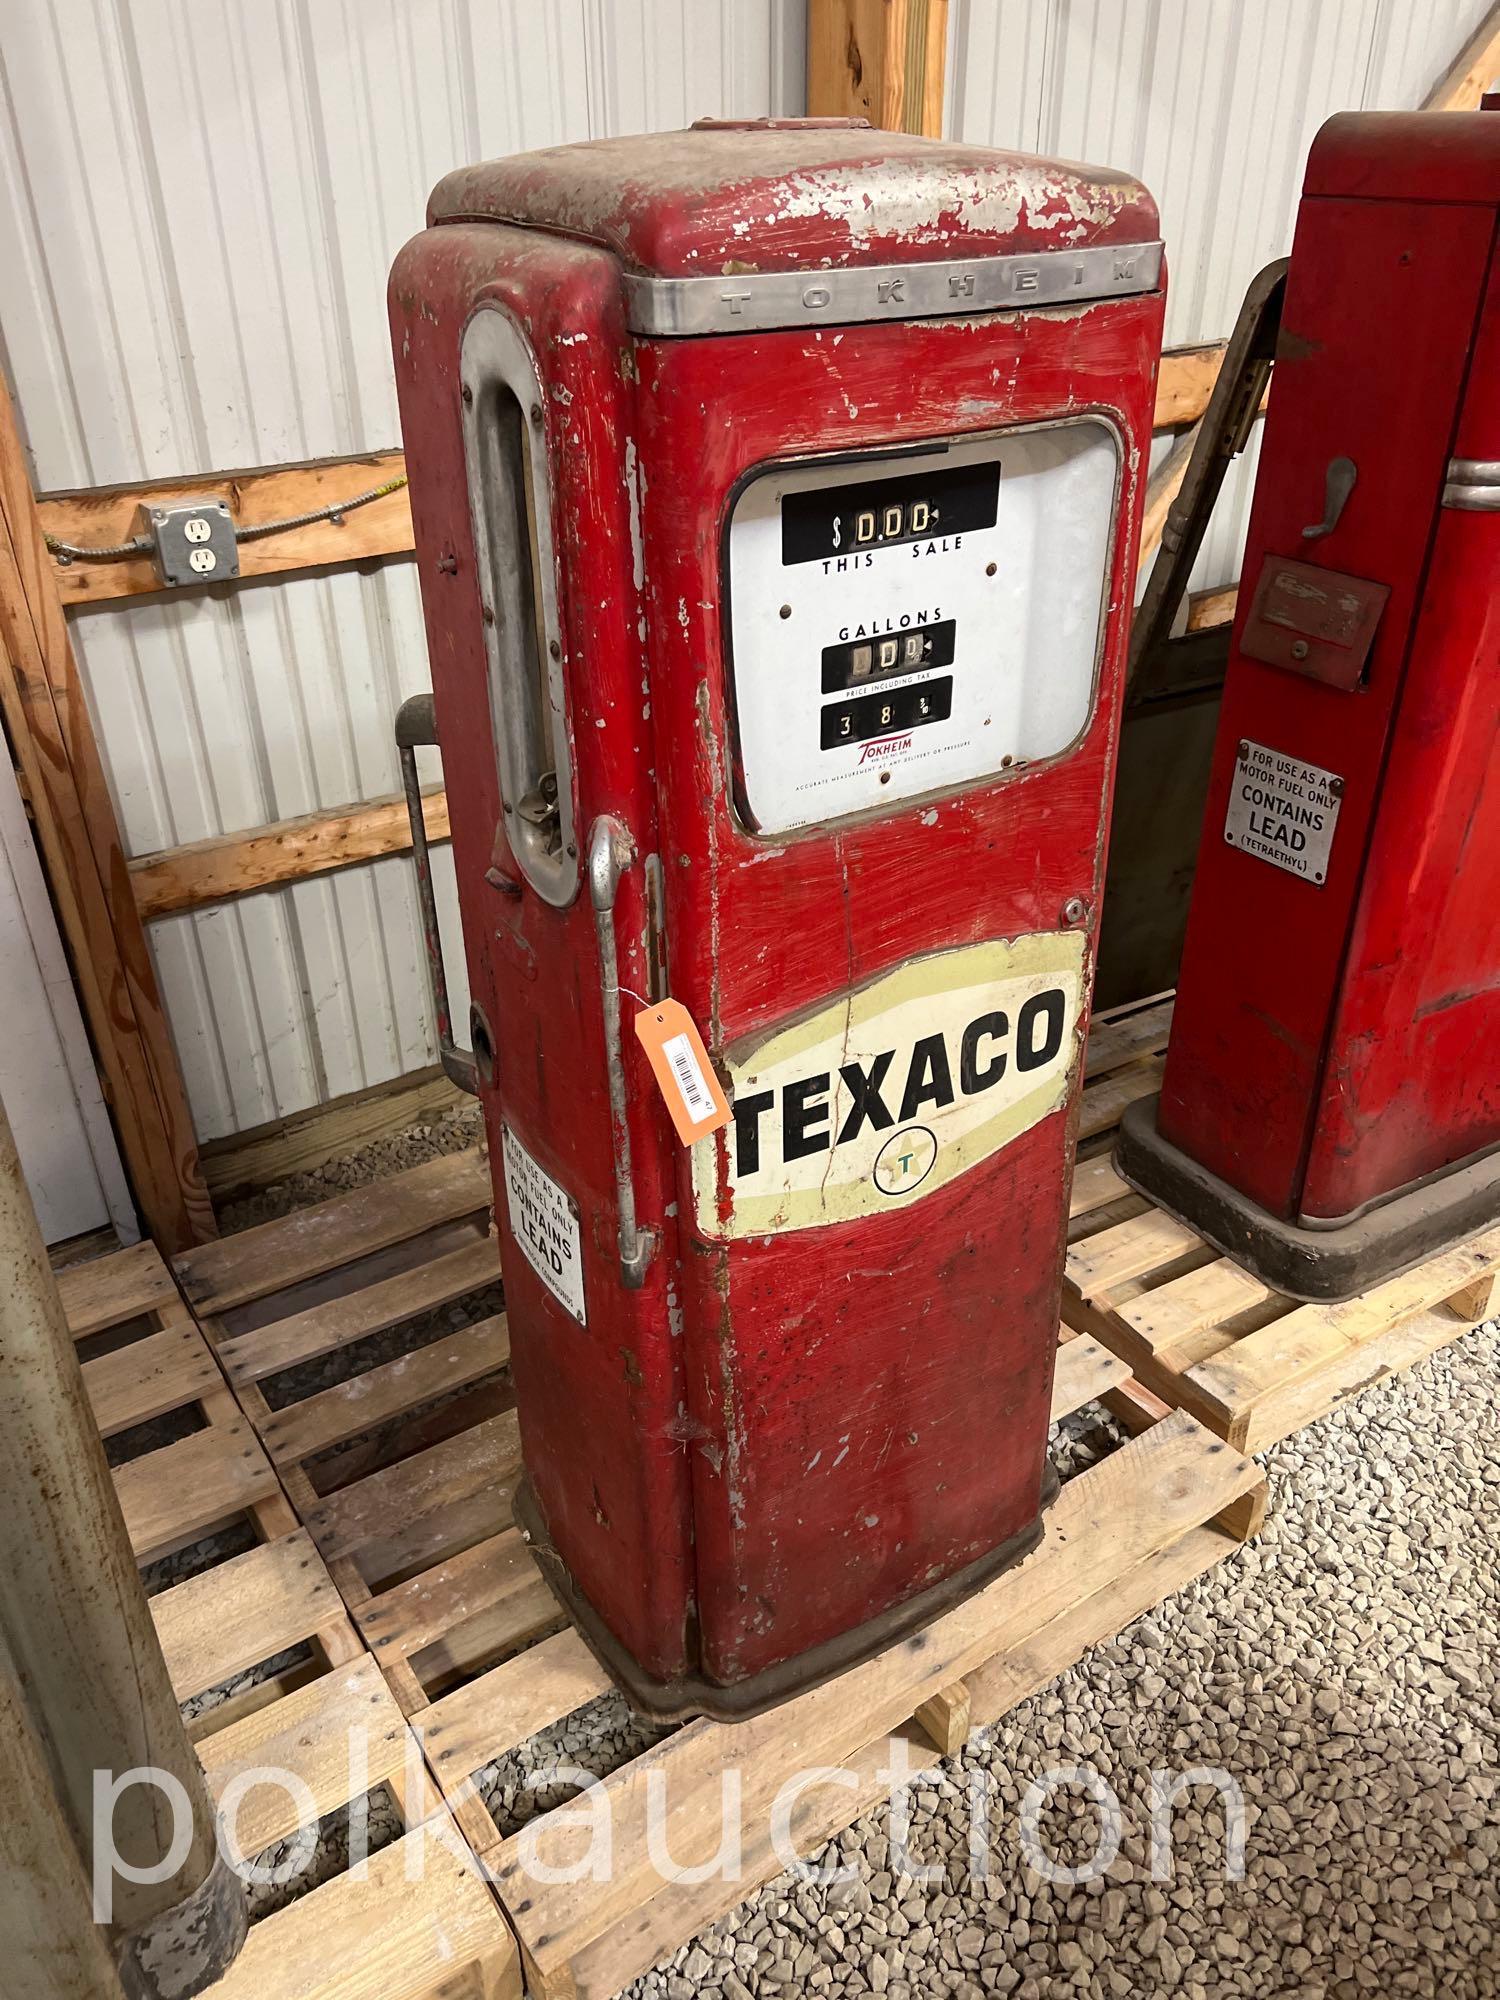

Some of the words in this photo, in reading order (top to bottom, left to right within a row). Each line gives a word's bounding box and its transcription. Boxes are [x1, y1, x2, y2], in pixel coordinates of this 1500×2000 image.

[721, 259, 1138, 315] TOKHEIM
[822, 553, 873, 575] THIS
[912, 536, 963, 558] SALE
[838, 607, 942, 641] GALLONS
[846, 687, 867, 698] PRICE
[871, 676, 913, 692] INCLUDING
[917, 672, 931, 681] TAX
[858, 731, 914, 765] TOKHEIM
[795, 779, 828, 791] ACCURATE
[831, 766, 875, 782] MEASUREMENT
[904, 751, 931, 763] DELIVERY
[1239, 762, 1275, 786] MOTOR
[1278, 778, 1304, 798] FUEL
[1308, 790, 1337, 810] ONLY
[1252, 750, 1273, 768] FOR
[1276, 759, 1298, 778] USE
[1300, 770, 1316, 785] AS
[1318, 777, 1327, 790] A
[1241, 784, 1324, 831] CONTAINS
[1250, 811, 1306, 851] LEAD
[1240, 833, 1307, 873] (TETRAETHYL)
[731, 988, 1066, 1179] TEXACO
[511, 1140, 523, 1161] FOR
[525, 1159, 539, 1184] USE
[543, 1180, 553, 1199] AS
[557, 1194, 563, 1209] A
[897, 1152, 914, 1174] T
[506, 1147, 528, 1186] MOTOR
[530, 1182, 548, 1211] FUEL
[552, 1207, 573, 1235] ONLY
[511, 1174, 572, 1260] CONTAINS
[521, 1210, 563, 1276] LEAD
